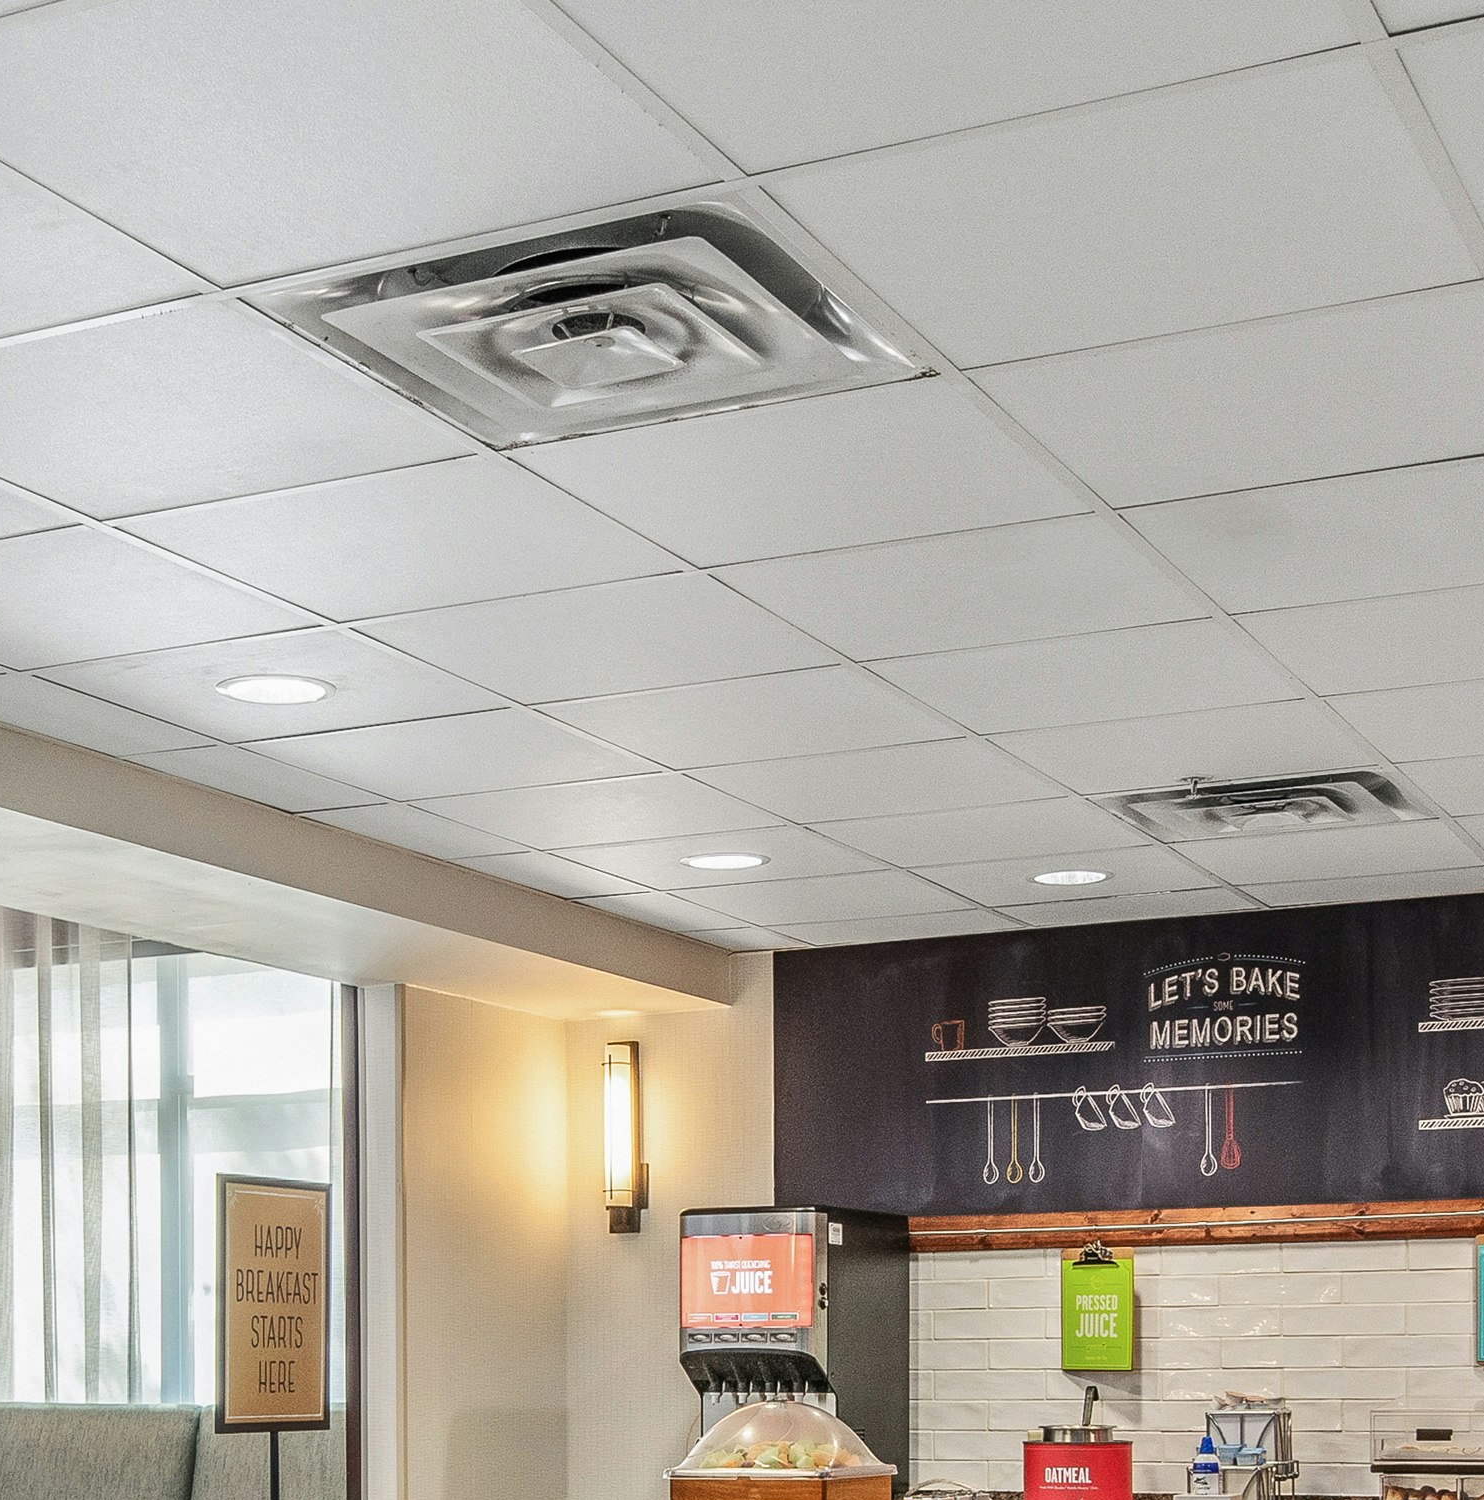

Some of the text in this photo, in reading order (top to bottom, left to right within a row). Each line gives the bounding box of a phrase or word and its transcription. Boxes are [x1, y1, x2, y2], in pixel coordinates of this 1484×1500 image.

[1147, 966, 1302, 1012] LET'S BAKE
[1212, 1001, 1235, 1013] SOME
[1149, 1012, 1299, 1051] MEMORIES
[254, 1224, 303, 1260] HAPPY
[236, 1268, 319, 1305] BREAKFAST
[730, 1270, 773, 1294] JUICE
[1075, 1294, 1119, 1312] PRESSED
[251, 1314, 304, 1349] STARTS
[1075, 1312, 1119, 1339] JUICE
[258, 1360, 296, 1393] HERE
[1044, 1466, 1093, 1484] OATMEAL
